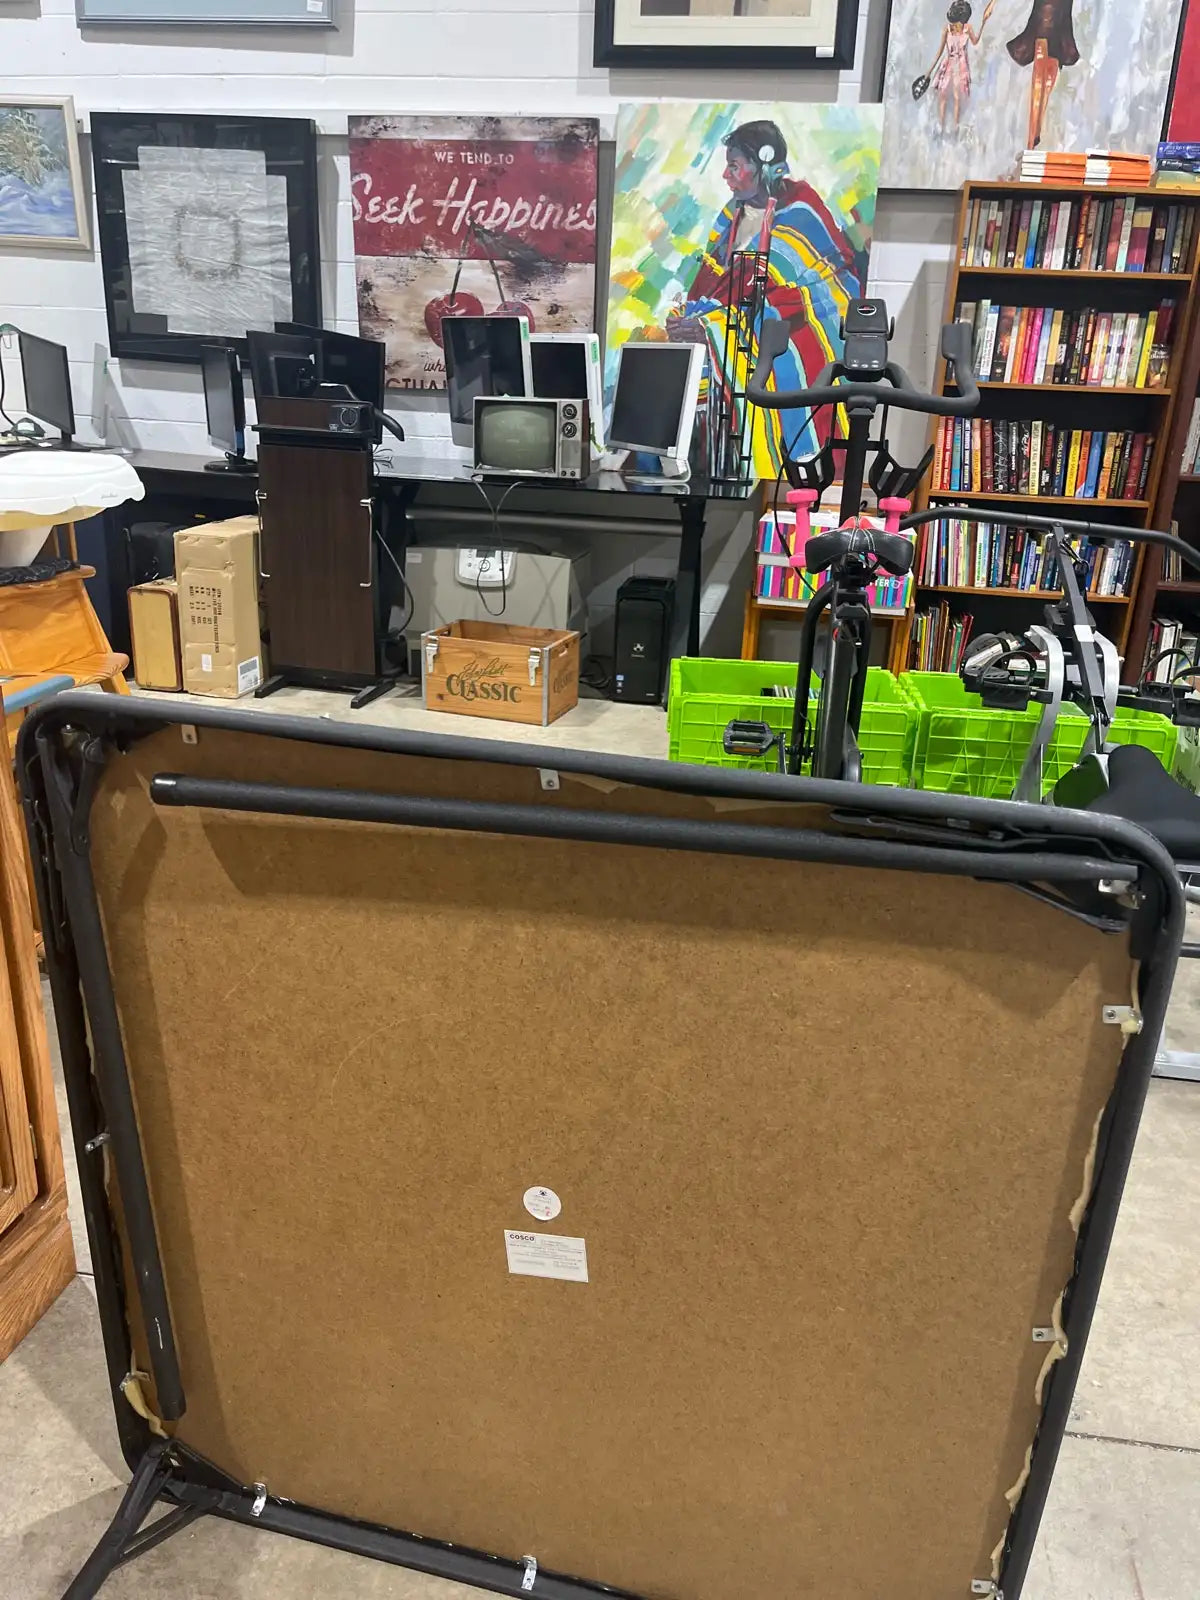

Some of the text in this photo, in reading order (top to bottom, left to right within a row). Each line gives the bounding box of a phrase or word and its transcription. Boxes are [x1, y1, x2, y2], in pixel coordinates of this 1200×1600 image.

[434, 151, 514, 165] WE TEND TO
[351, 173, 427, 225] Seek
[446, 674, 522, 704] CLASSIC
[509, 1233, 535, 1241] COSCO
